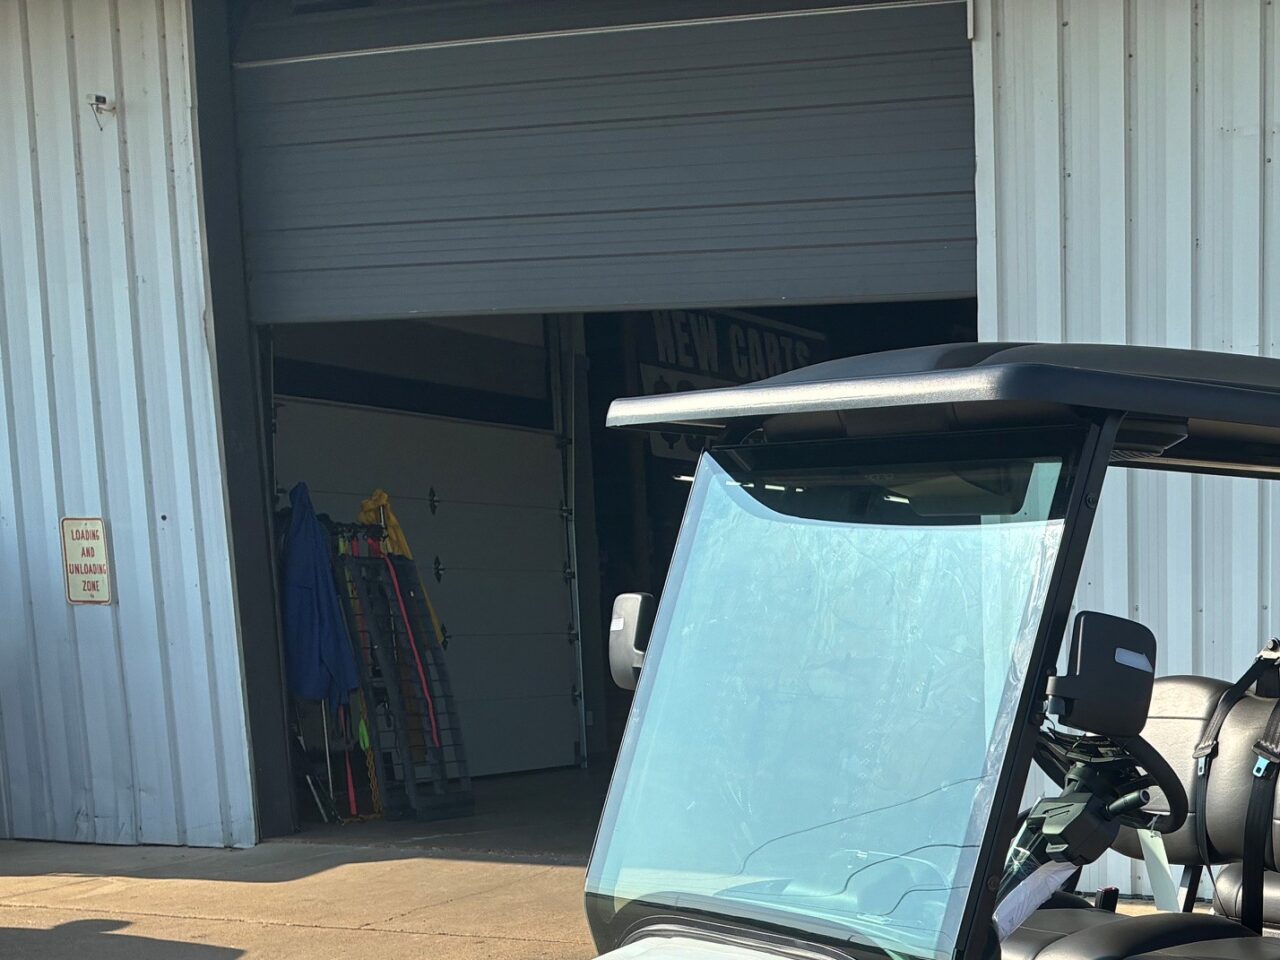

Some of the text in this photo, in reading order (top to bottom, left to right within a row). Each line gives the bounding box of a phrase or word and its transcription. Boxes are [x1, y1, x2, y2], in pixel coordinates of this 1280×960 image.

[652, 310, 719, 373] NEW
[71, 529, 100, 541] LOADING
[81, 546, 95, 558] AND
[68, 563, 107, 575] UNLOADING
[82, 580, 100, 592] ZONE
